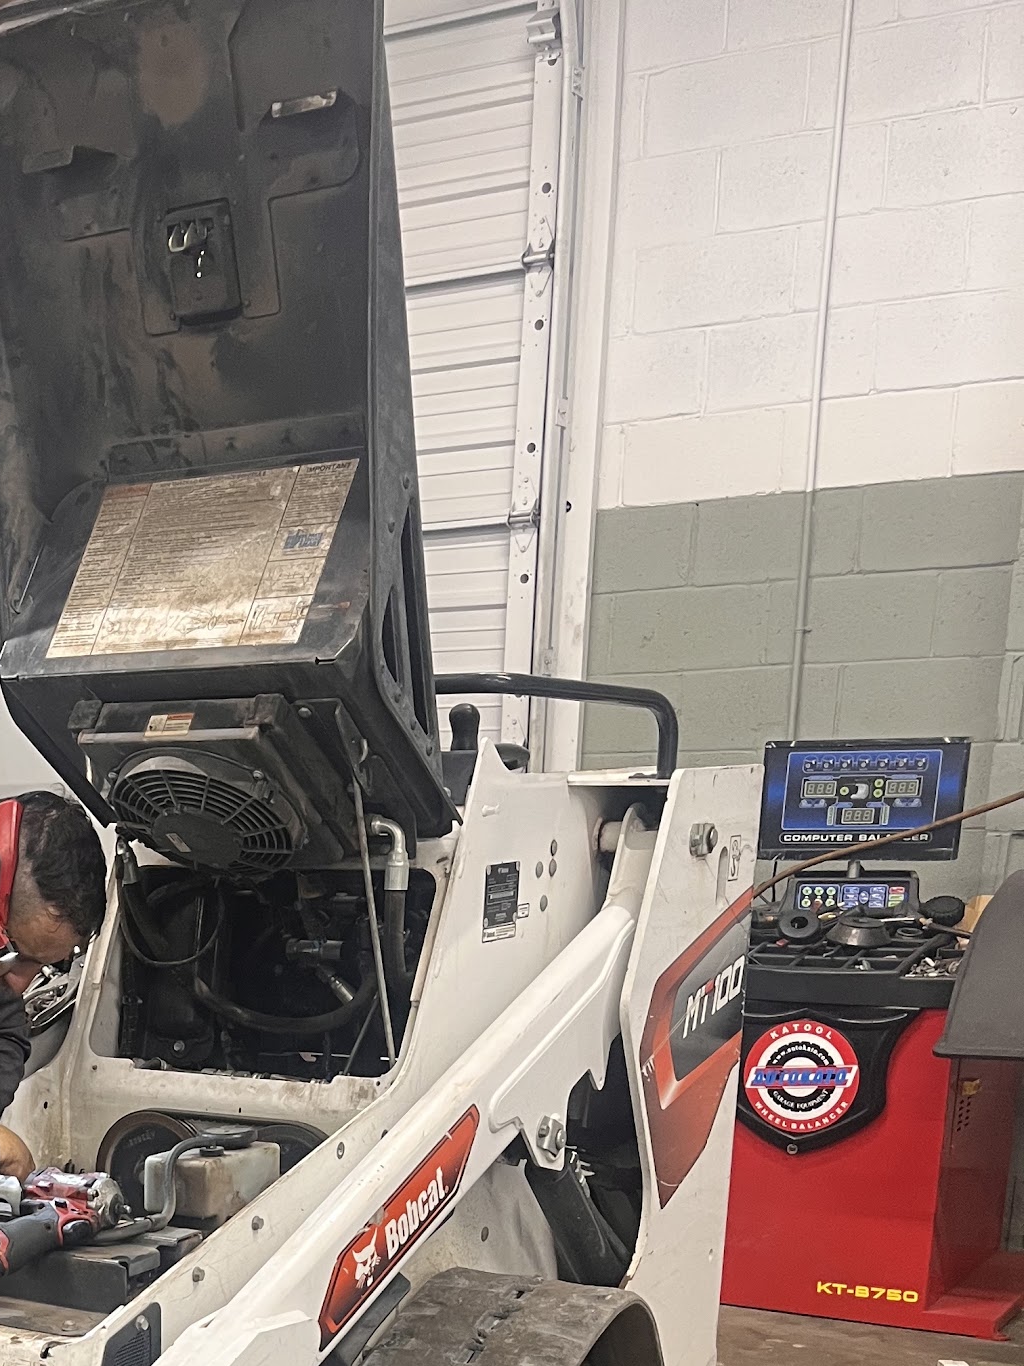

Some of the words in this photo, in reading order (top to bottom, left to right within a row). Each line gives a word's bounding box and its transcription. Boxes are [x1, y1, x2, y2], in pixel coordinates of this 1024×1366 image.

[783, 834, 853, 843] COMPUTER
[682, 954, 745, 1039] MT100
[769, 1023, 833, 1040] KATOOL
[773, 1090, 795, 1109] GARAGE
[796, 1088, 829, 1110] EQUIPMENT
[384, 1166, 447, 1261] Bobcat
